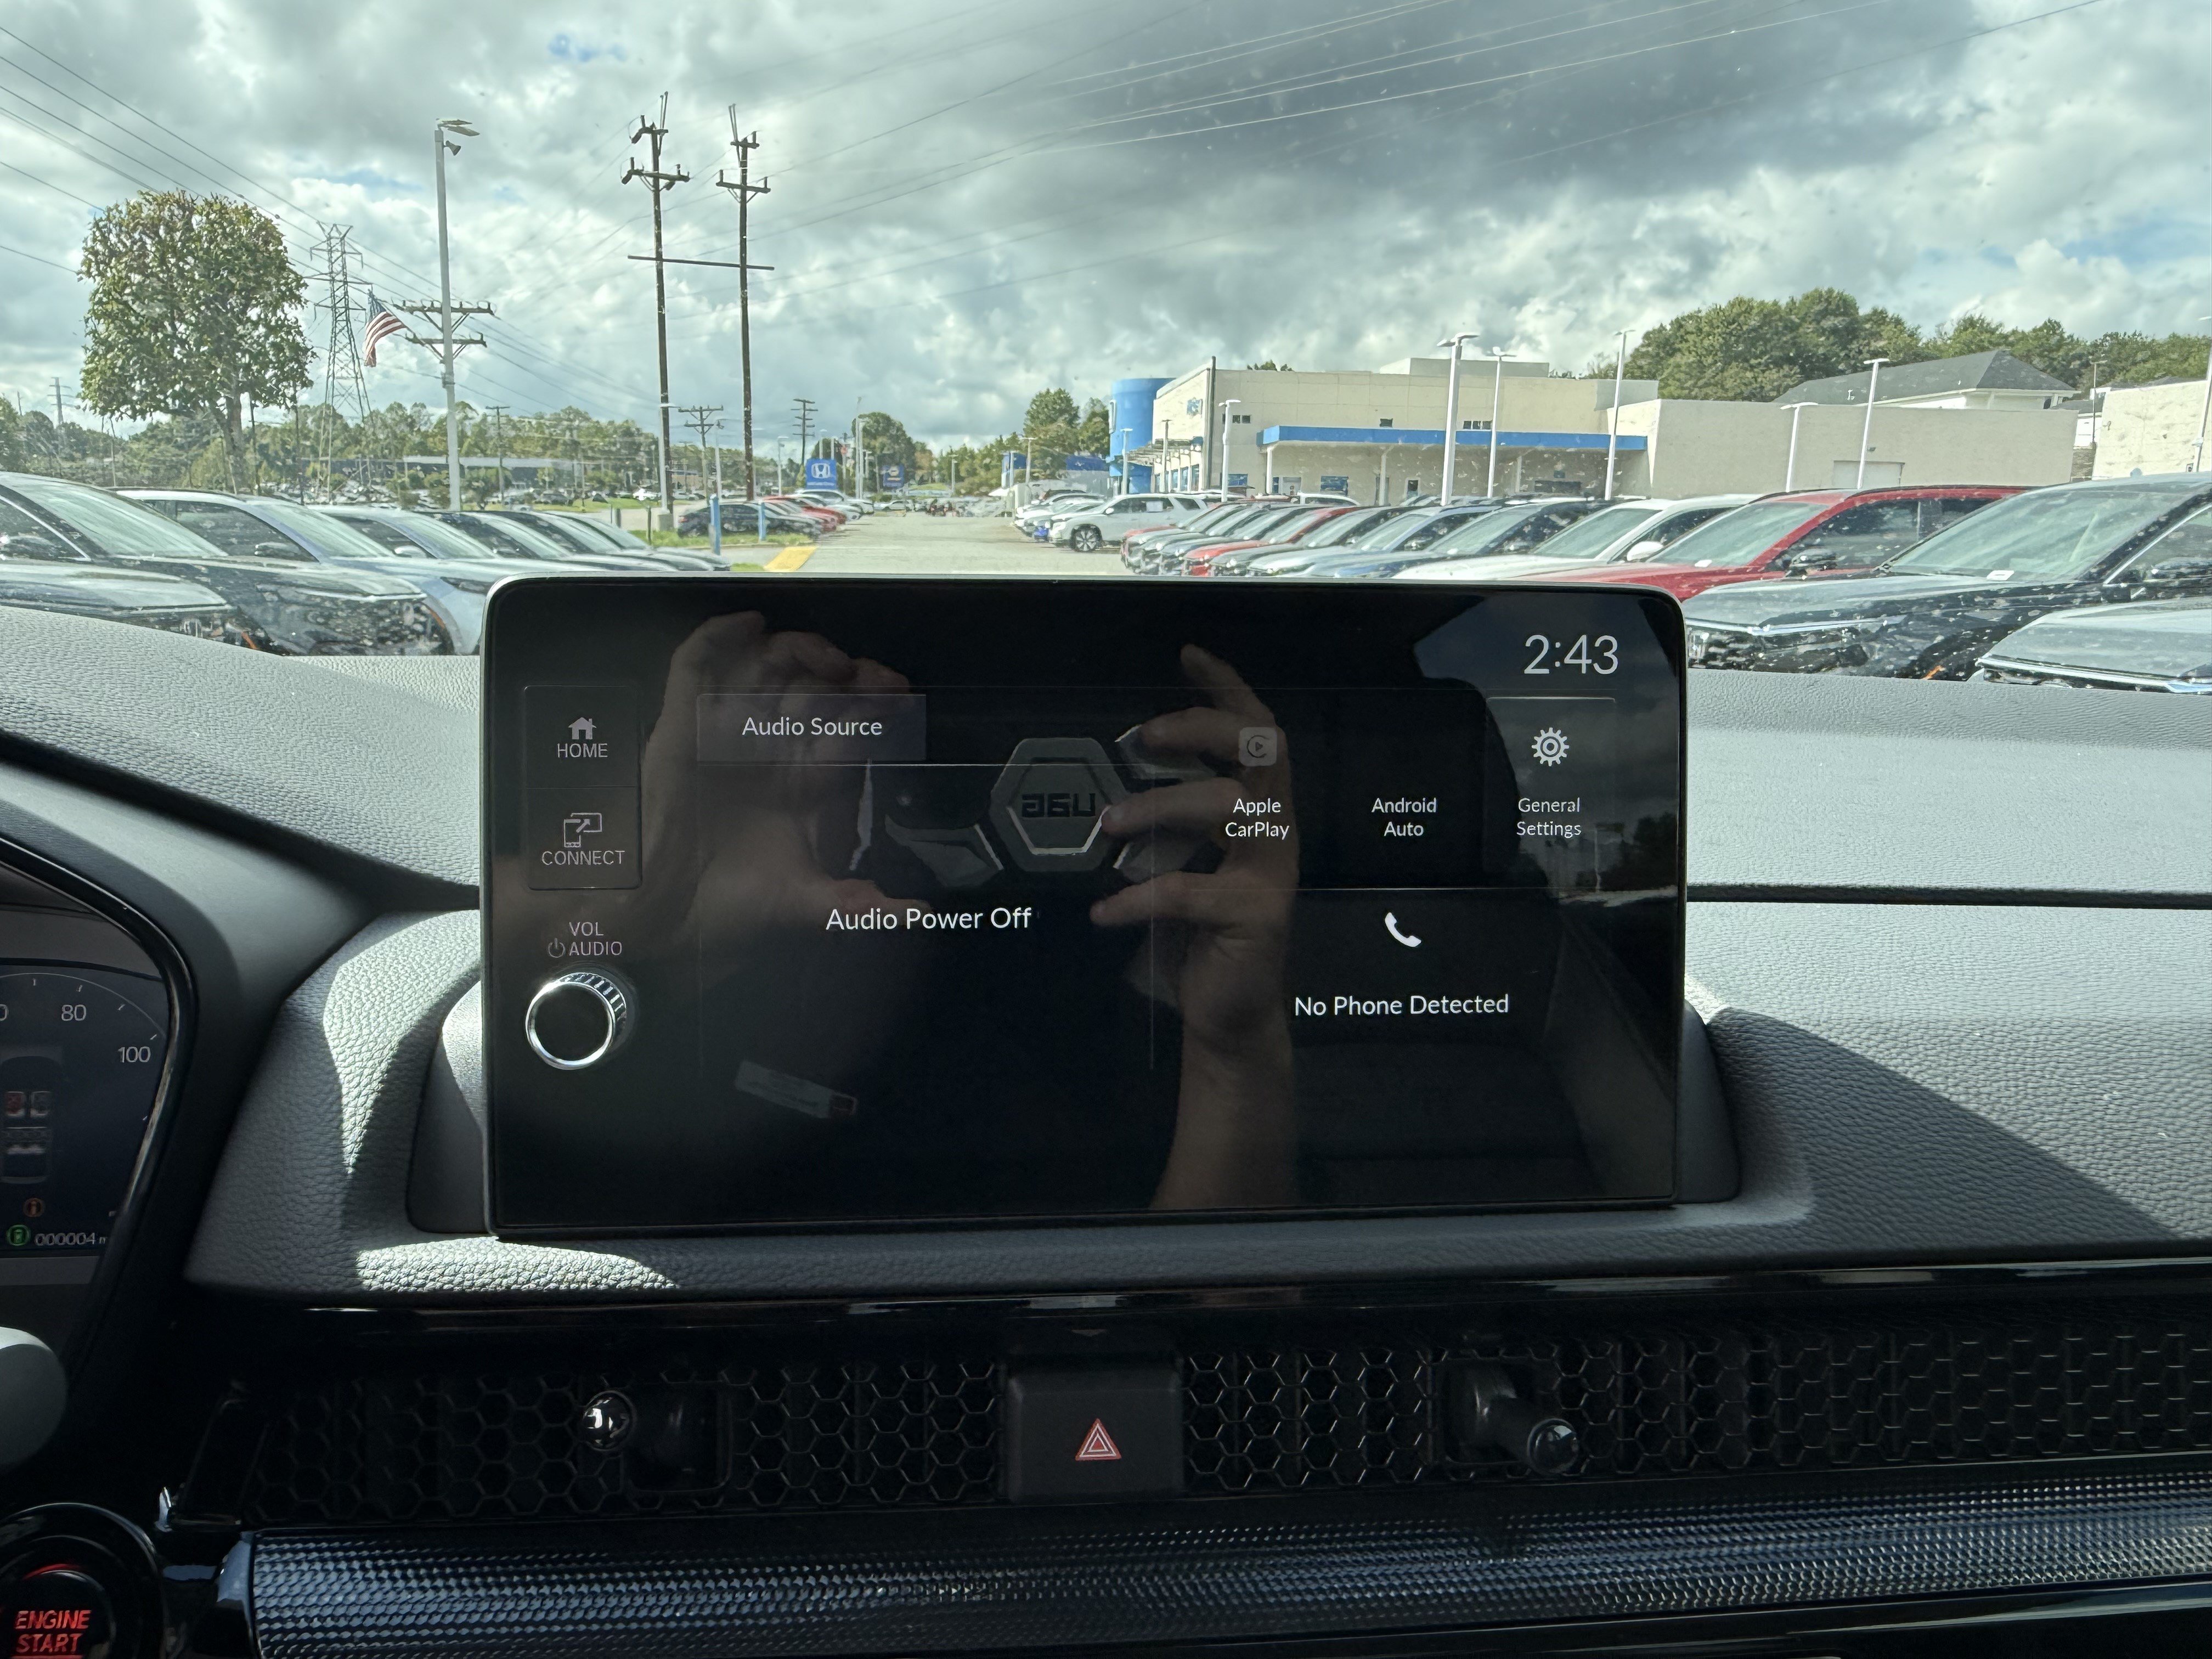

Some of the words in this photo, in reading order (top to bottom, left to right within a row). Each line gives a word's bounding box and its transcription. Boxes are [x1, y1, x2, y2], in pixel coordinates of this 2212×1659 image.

[1525, 635, 1618, 674] 2:43
[742, 717, 804, 735] Audio
[811, 718, 882, 735] Source
[557, 743, 607, 758] HOME
[1233, 798, 1280, 816] Apple
[1372, 798, 1436, 812] Android
[1519, 798, 1579, 812] General
[1226, 822, 1289, 839] CarPlay
[1384, 822, 1424, 836] Auto
[1517, 821, 1581, 838] Settings
[542, 850, 625, 865] CONNECT
[826, 908, 897, 929] Audio
[907, 909, 983, 929] Power
[991, 907, 1031, 928] Off
[569, 922, 603, 936] VOL
[569, 941, 622, 956] AUDIO
[61, 1005, 86, 1021] 80
[1296, 997, 1326, 1015] No
[1335, 996, 1402, 1015] Phone
[1410, 994, 1508, 1014] Detected
[119, 1046, 150, 1063] 100
[36, 1233, 95, 1246] 000004
[15, 1610, 92, 1629] ENGINE
[17, 1633, 82, 1652] START
